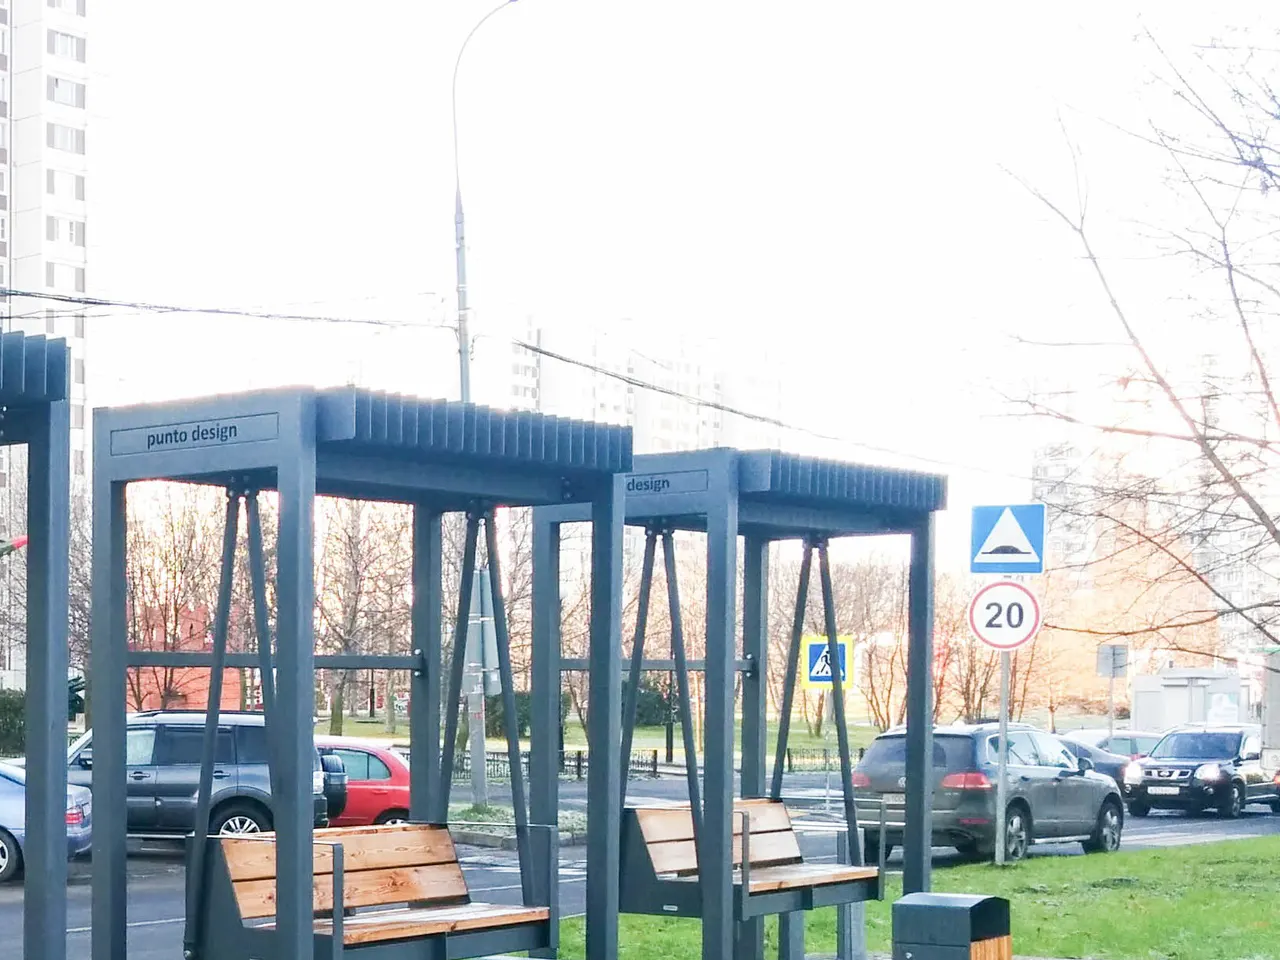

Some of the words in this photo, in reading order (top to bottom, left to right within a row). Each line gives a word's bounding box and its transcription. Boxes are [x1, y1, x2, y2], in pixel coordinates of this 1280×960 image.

[147, 428, 187, 449] punto
[192, 422, 237, 442] design
[627, 477, 670, 492] design
[985, 602, 1024, 628] 20
